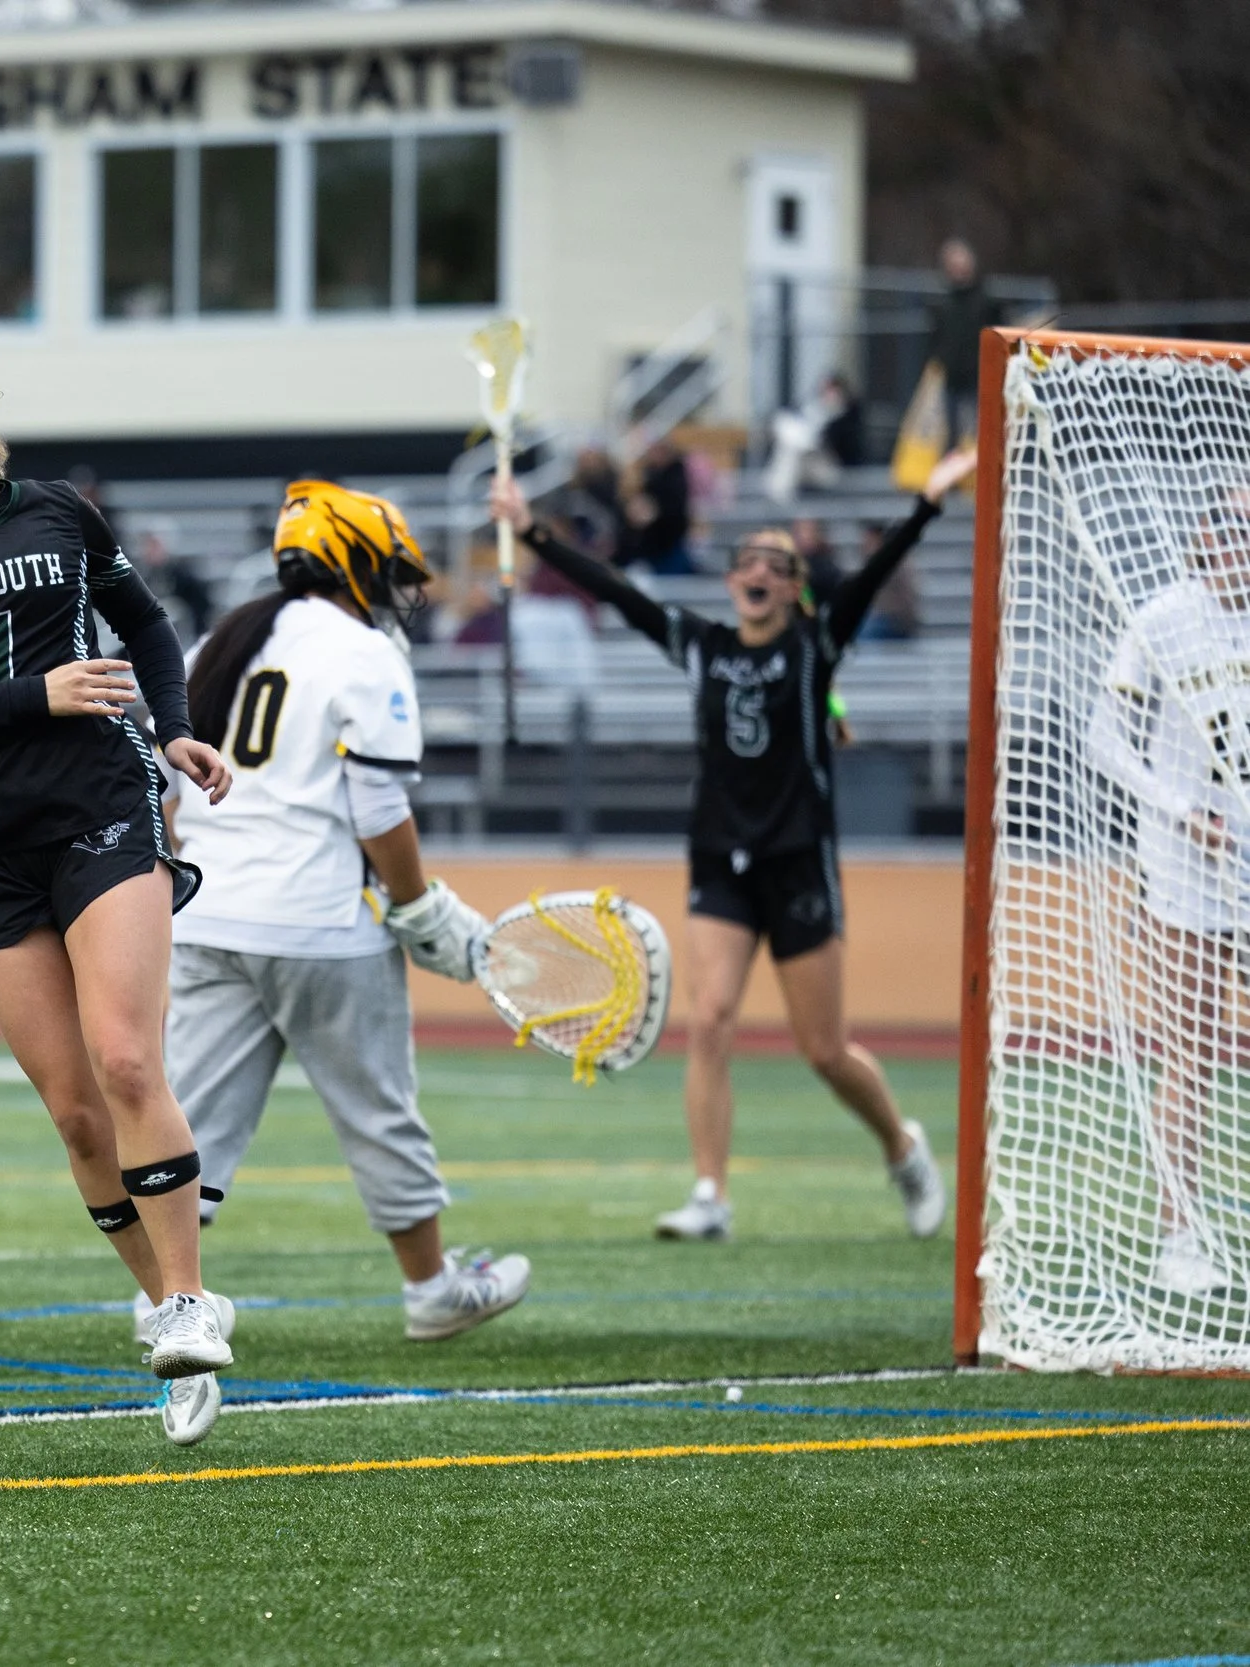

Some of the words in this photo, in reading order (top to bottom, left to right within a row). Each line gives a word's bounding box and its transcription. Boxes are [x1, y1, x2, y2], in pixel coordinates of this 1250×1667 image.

[249, 42, 500, 120] STATE
[231, 668, 290, 770] 0
[724, 682, 770, 758] 5
